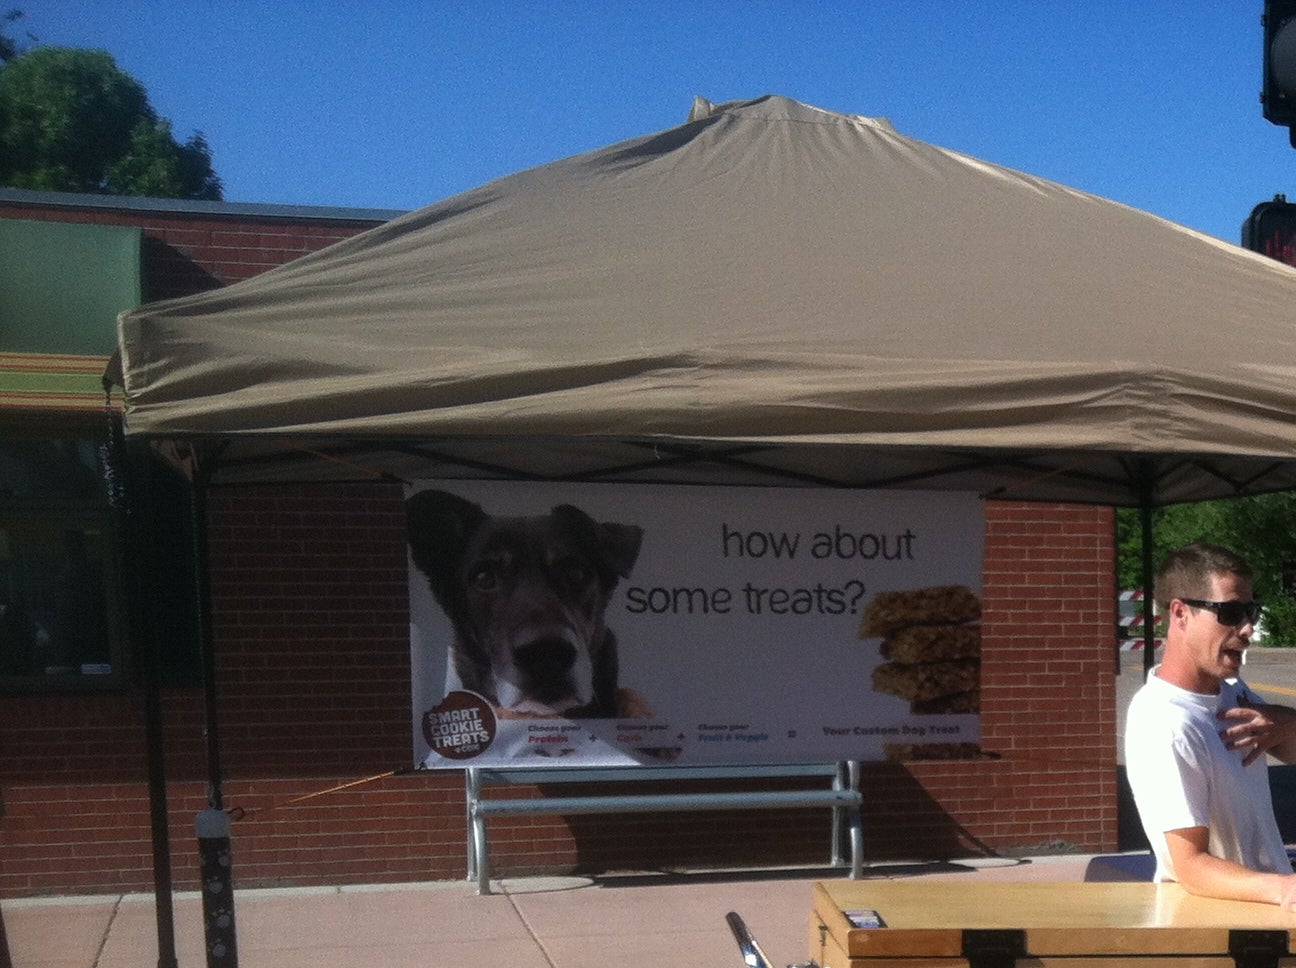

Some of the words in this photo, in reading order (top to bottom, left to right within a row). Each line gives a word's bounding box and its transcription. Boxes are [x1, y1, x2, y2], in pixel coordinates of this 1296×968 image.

[722, 522, 800, 559] how
[811, 524, 916, 560] about
[625, 587, 732, 614] some
[742, 580, 866, 615] treats?
[428, 708, 480, 724] SMART
[430, 719, 484, 736] COOKIE
[823, 726, 851, 736] Your
[853, 726, 899, 735] Custom
[902, 725, 926, 736] Dog
[928, 725, 960, 735] Treat
[433, 730, 490, 748] TREATS
